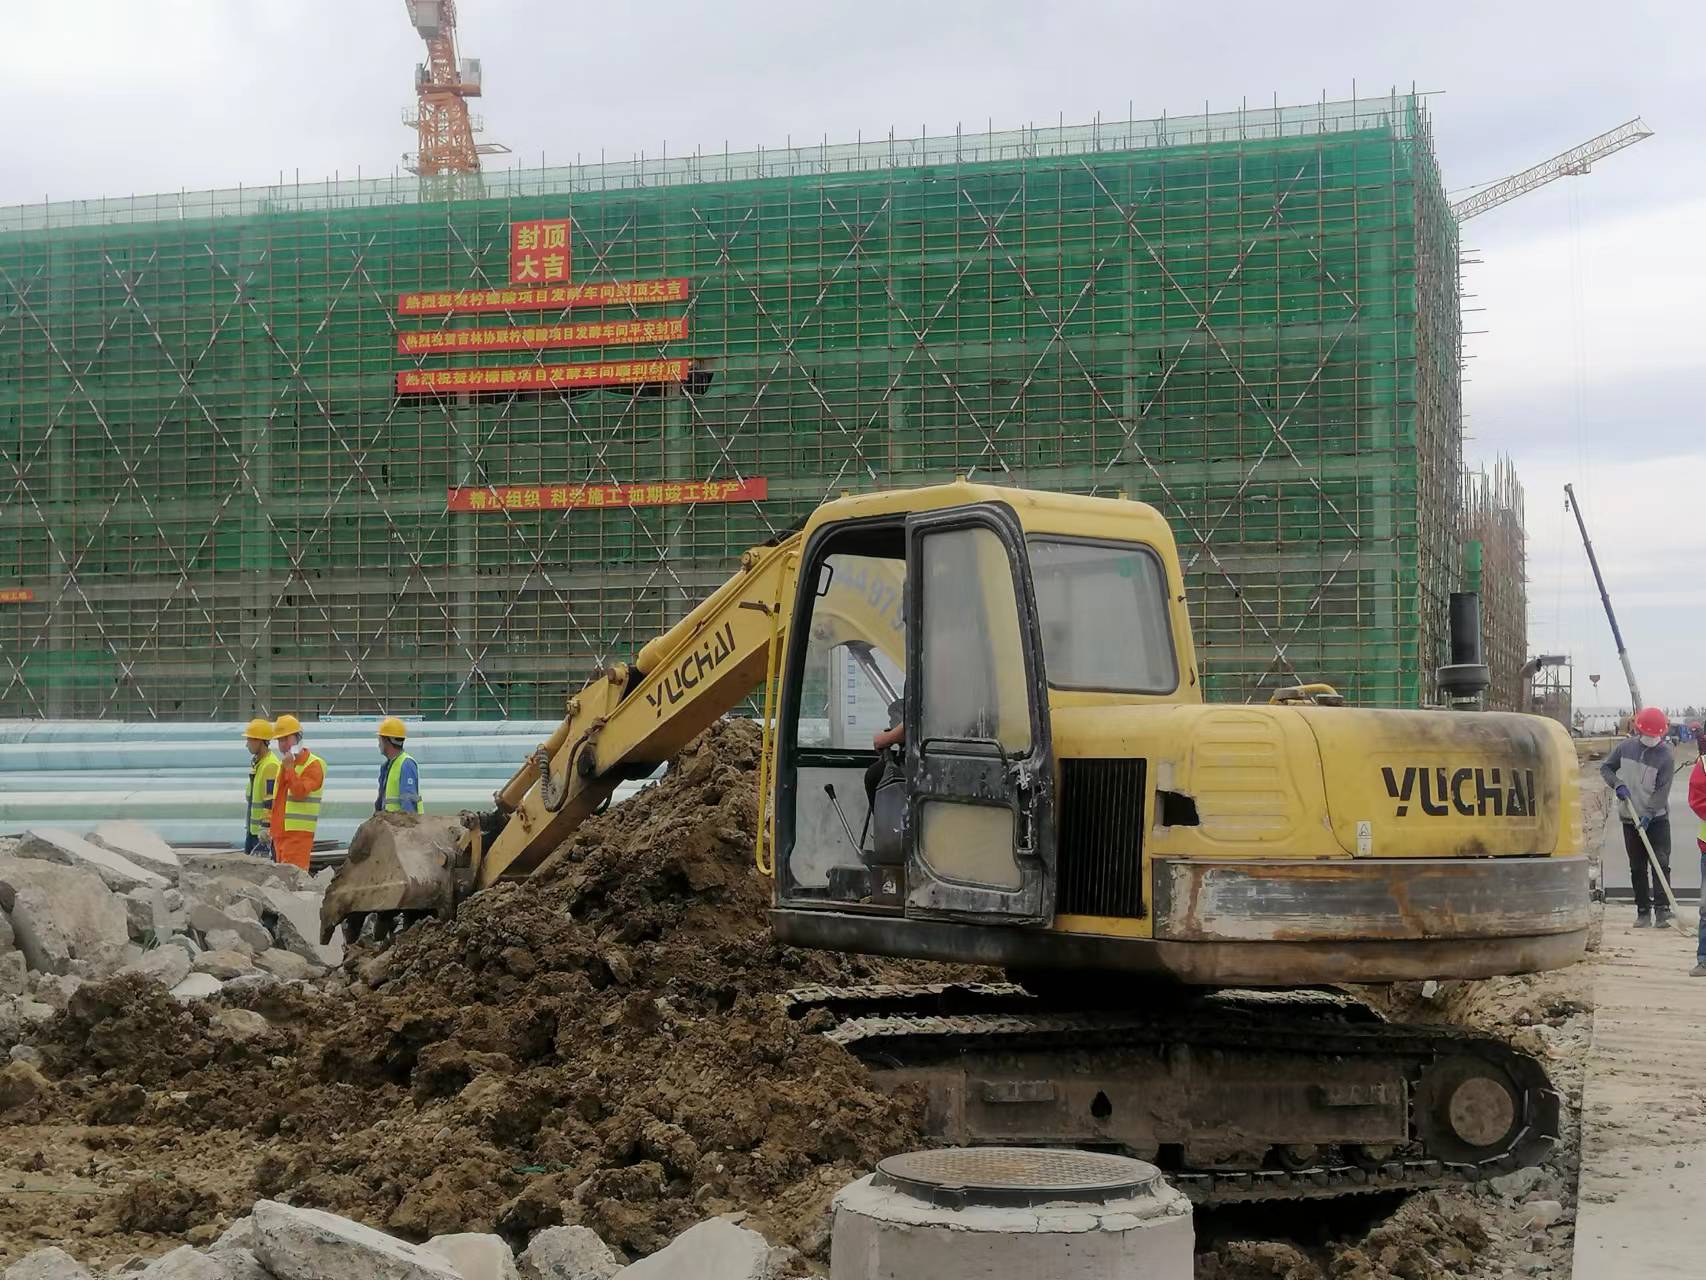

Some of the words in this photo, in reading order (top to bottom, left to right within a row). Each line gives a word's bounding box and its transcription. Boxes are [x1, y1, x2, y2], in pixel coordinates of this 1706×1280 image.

[518, 223, 566, 250] 封顶
[517, 253, 565, 280] 大吉
[646, 622, 736, 719] YUCHAI
[1381, 767, 1536, 817] YUCHAI
